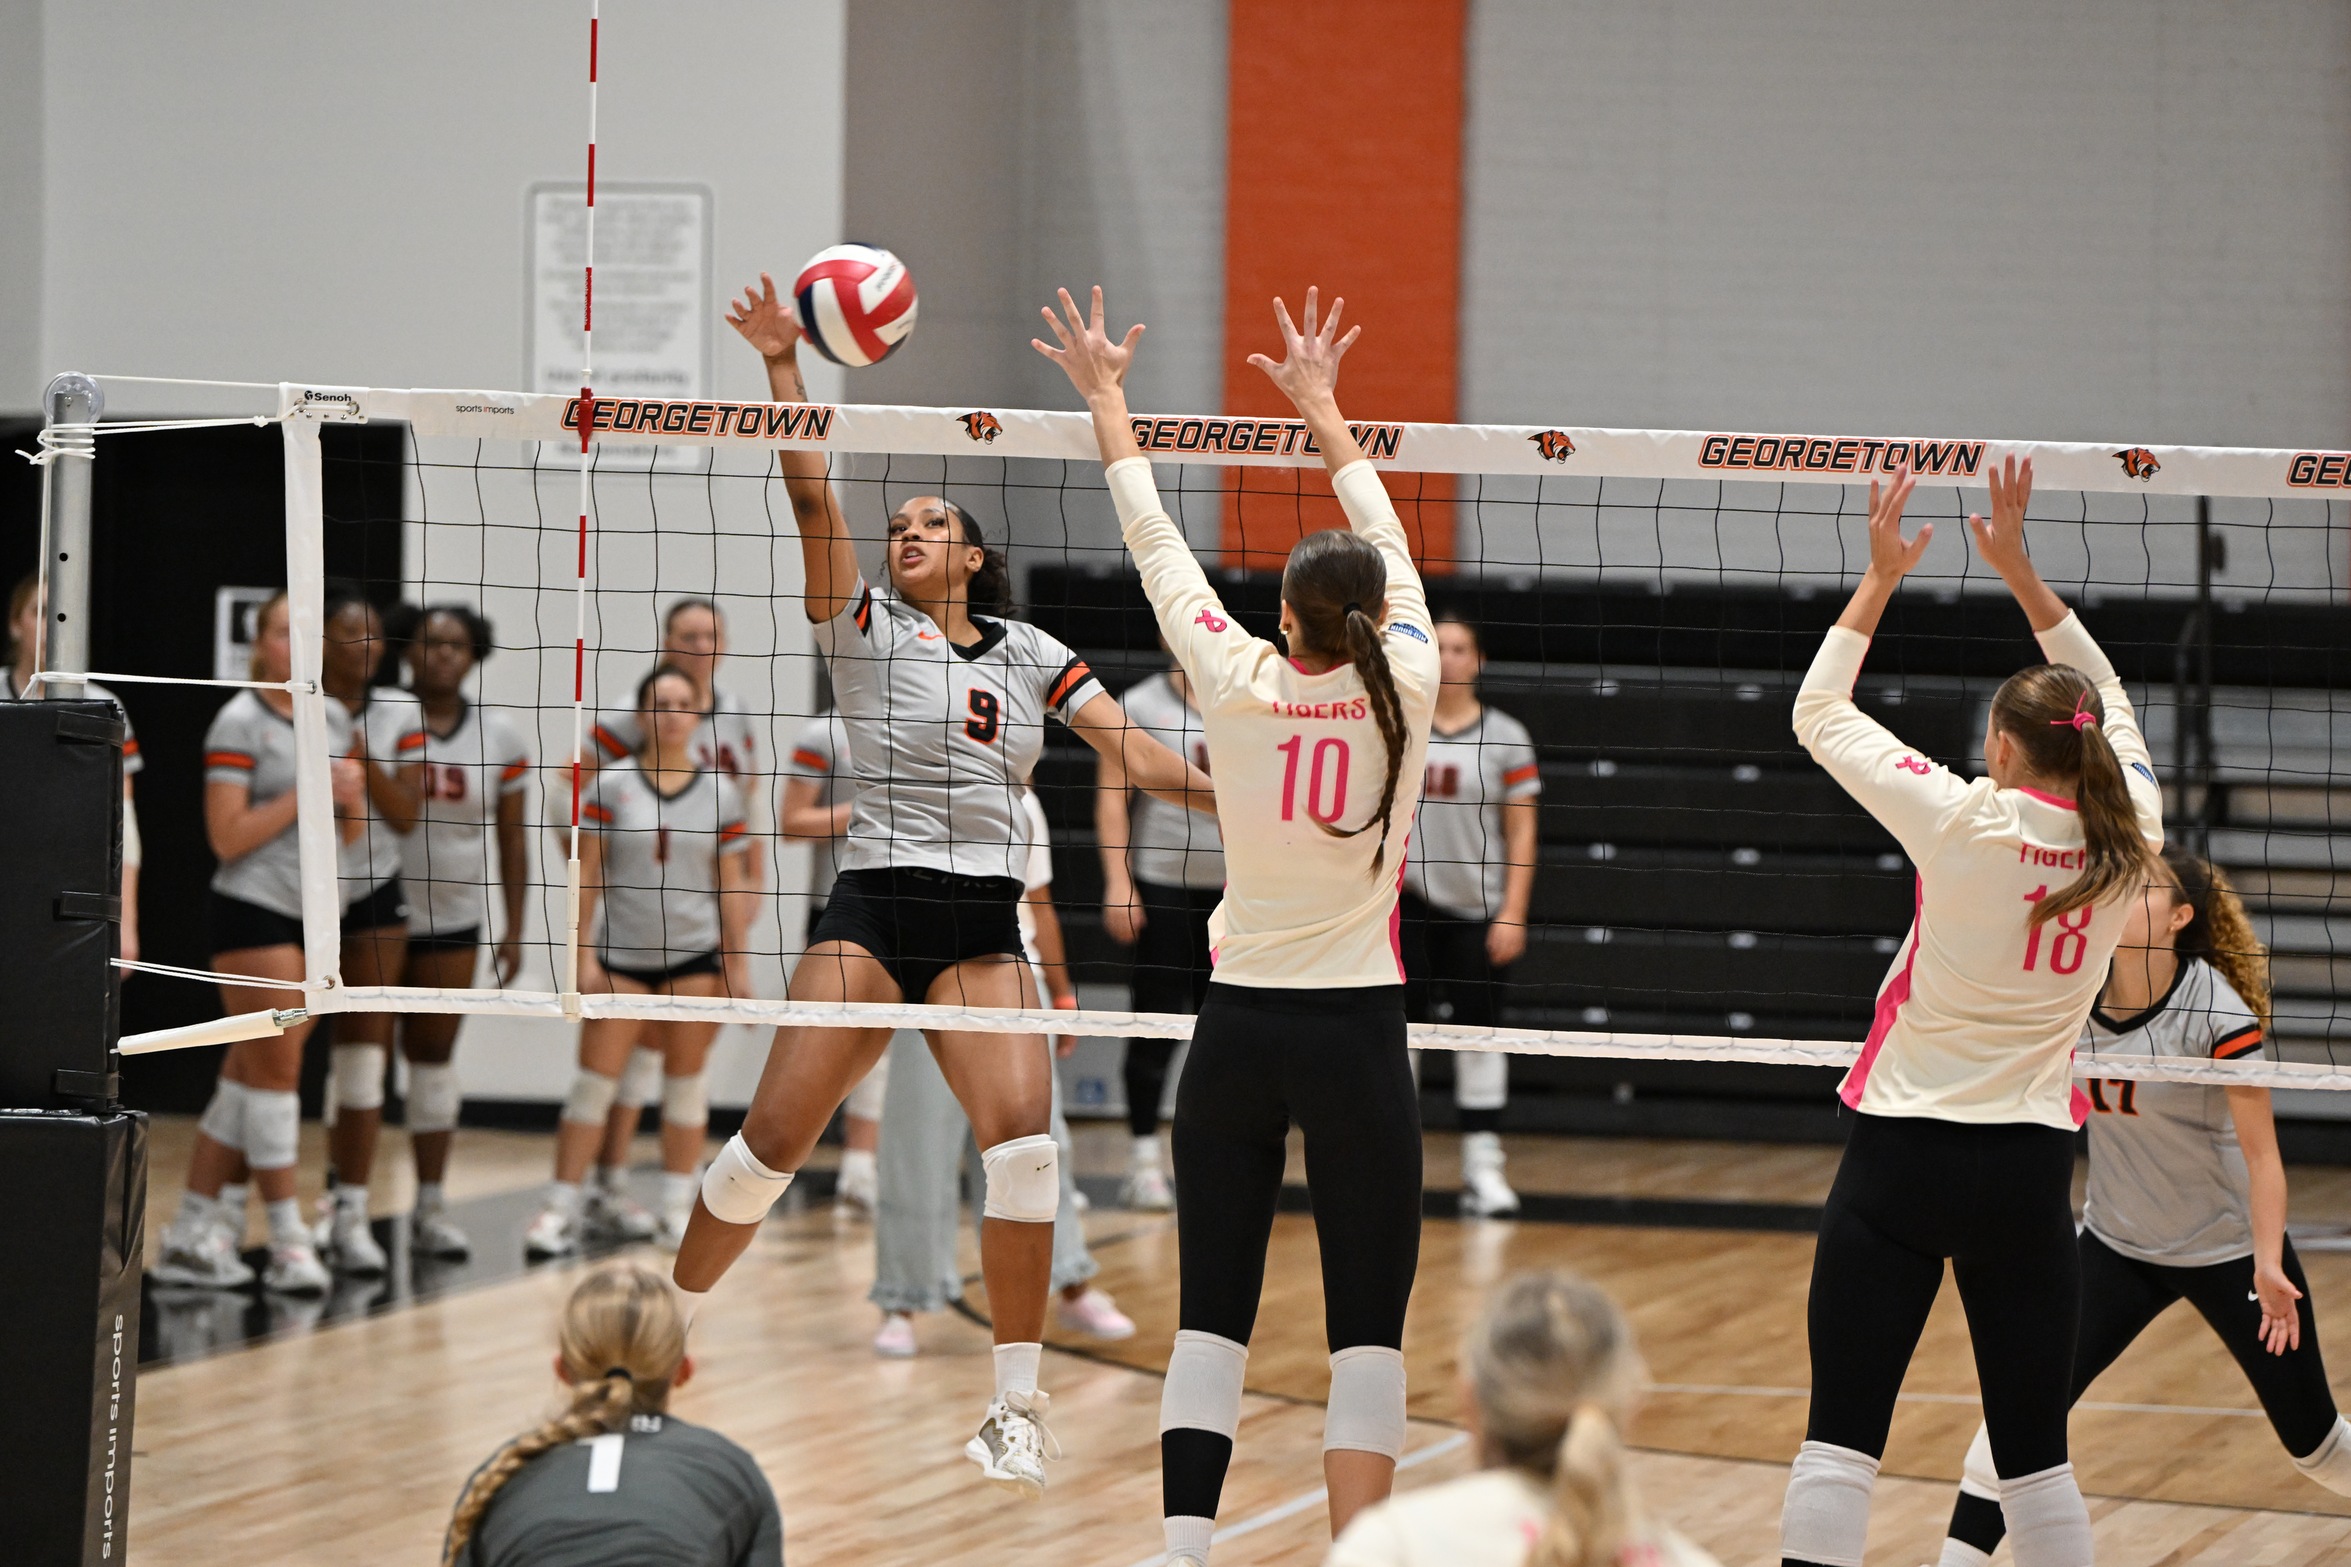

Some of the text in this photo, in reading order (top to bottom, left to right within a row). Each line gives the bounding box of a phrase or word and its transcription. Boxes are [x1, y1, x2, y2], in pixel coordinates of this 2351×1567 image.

[314, 392, 352, 402] Senoh
[455, 405, 515, 415] sports imports
[561, 397, 834, 441] GEORGETOWN
[1698, 434, 1986, 477] GEORGETOWN
[964, 687, 1000, 745] 9
[1277, 734, 1350, 824] 10
[2023, 884, 2093, 975] 18
[103, 1314, 124, 1560] sports imports
